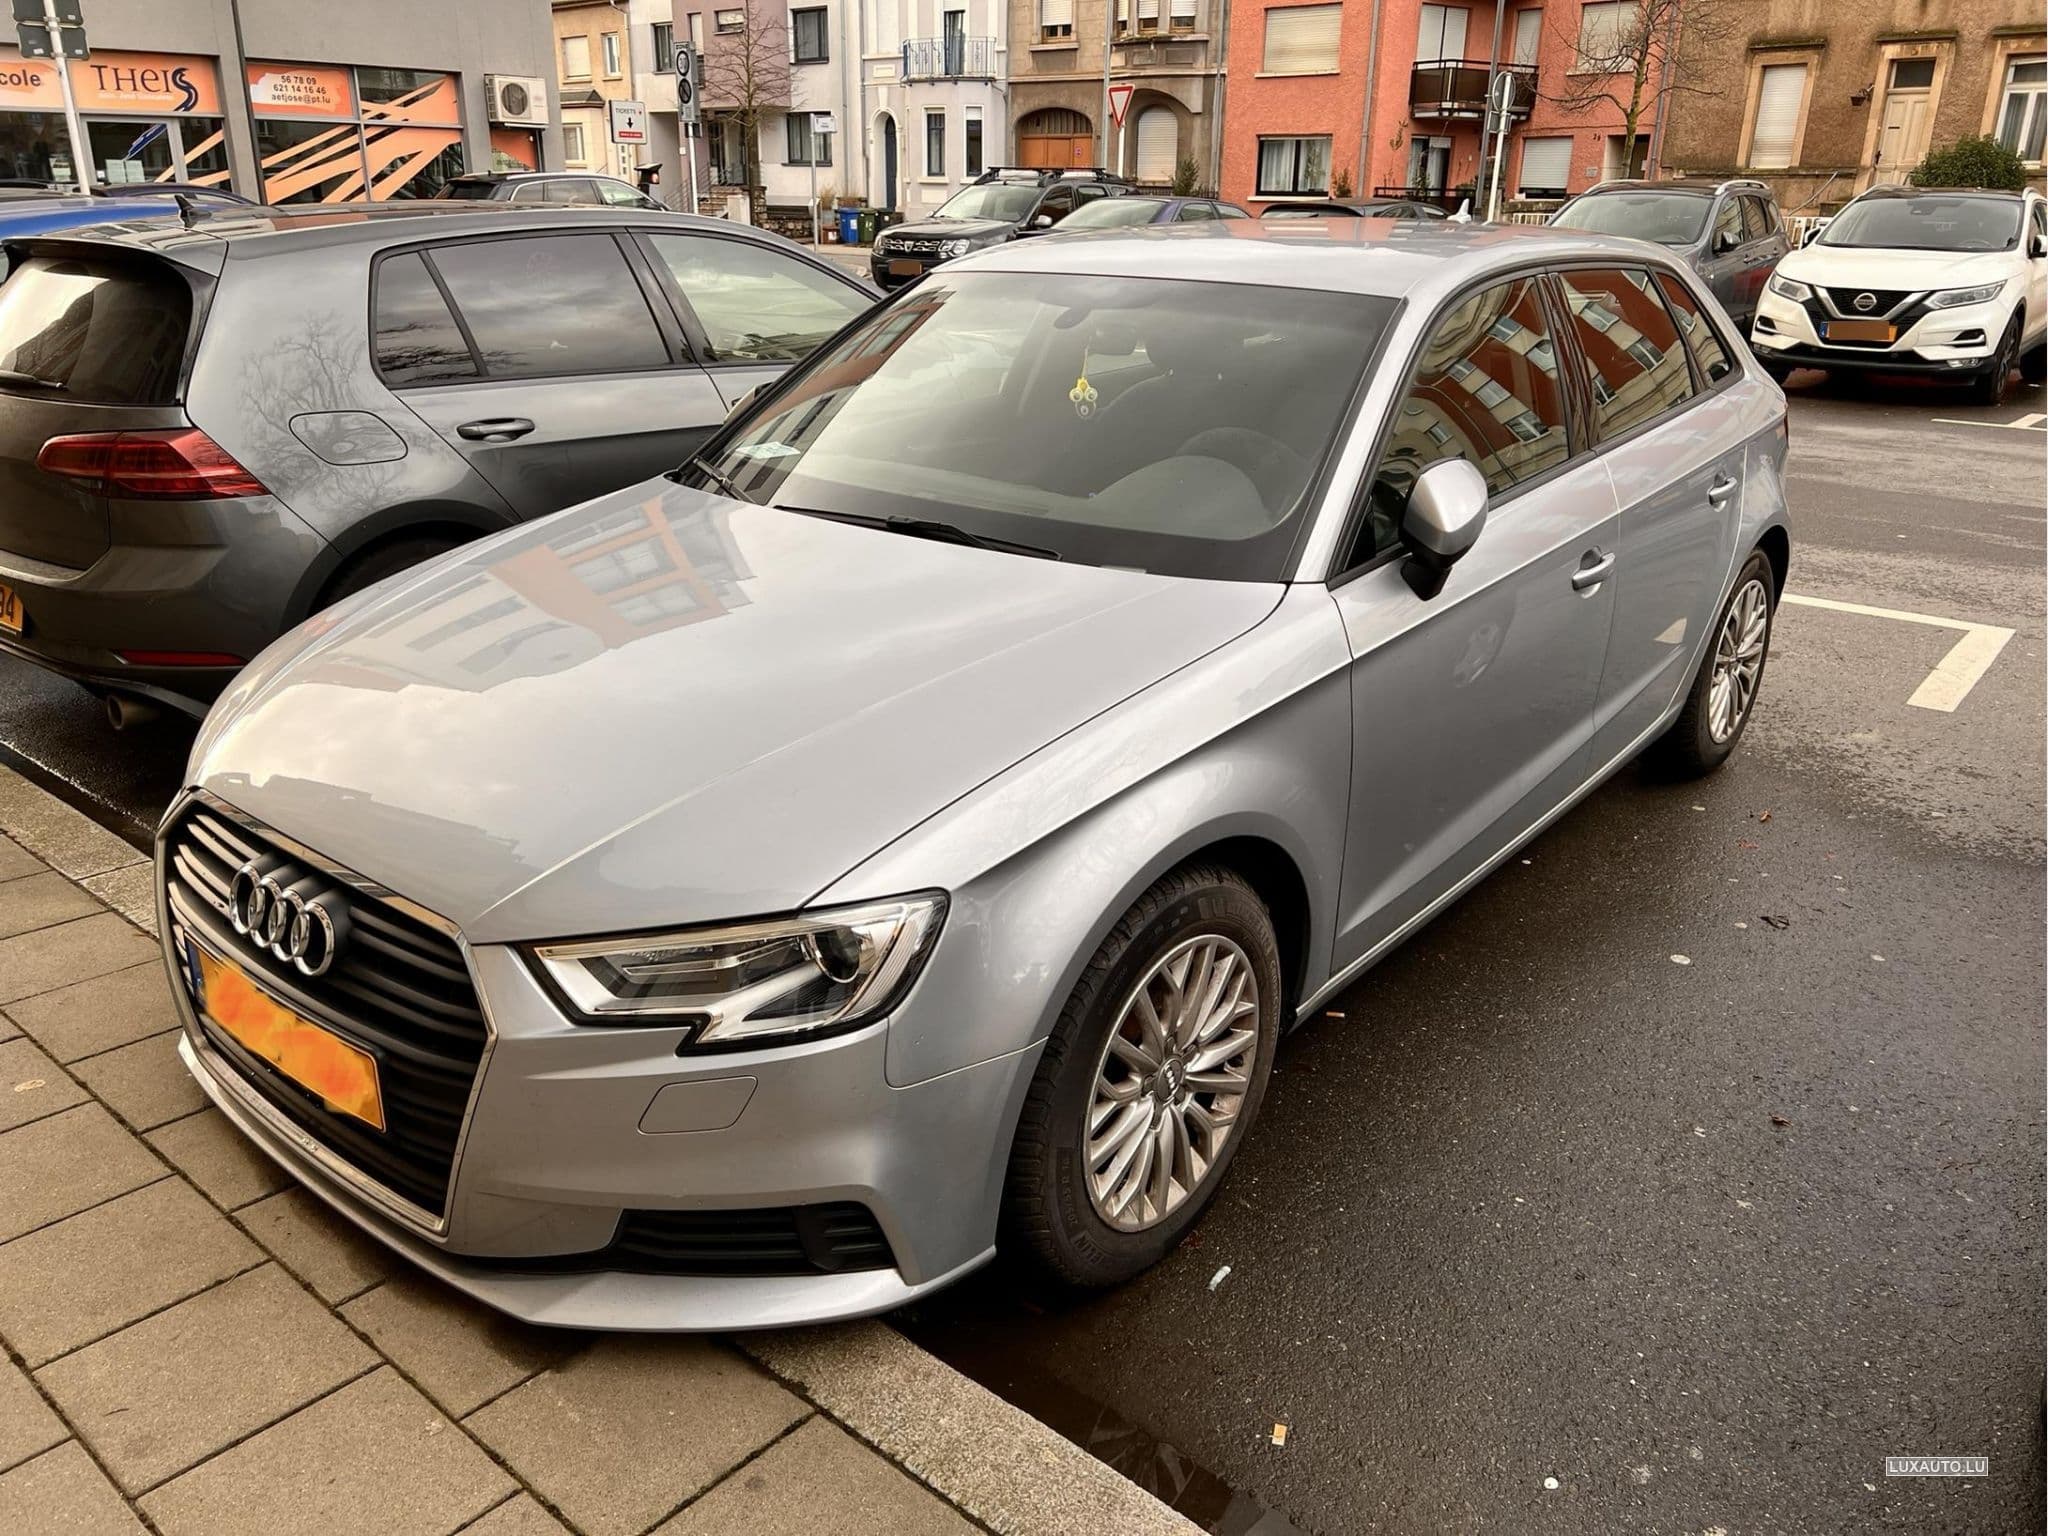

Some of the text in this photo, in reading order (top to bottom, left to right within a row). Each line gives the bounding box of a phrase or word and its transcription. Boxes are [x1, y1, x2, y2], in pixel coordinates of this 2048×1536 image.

[281, 75, 316, 85] 56 78 09
[273, 84, 288, 92] 621
